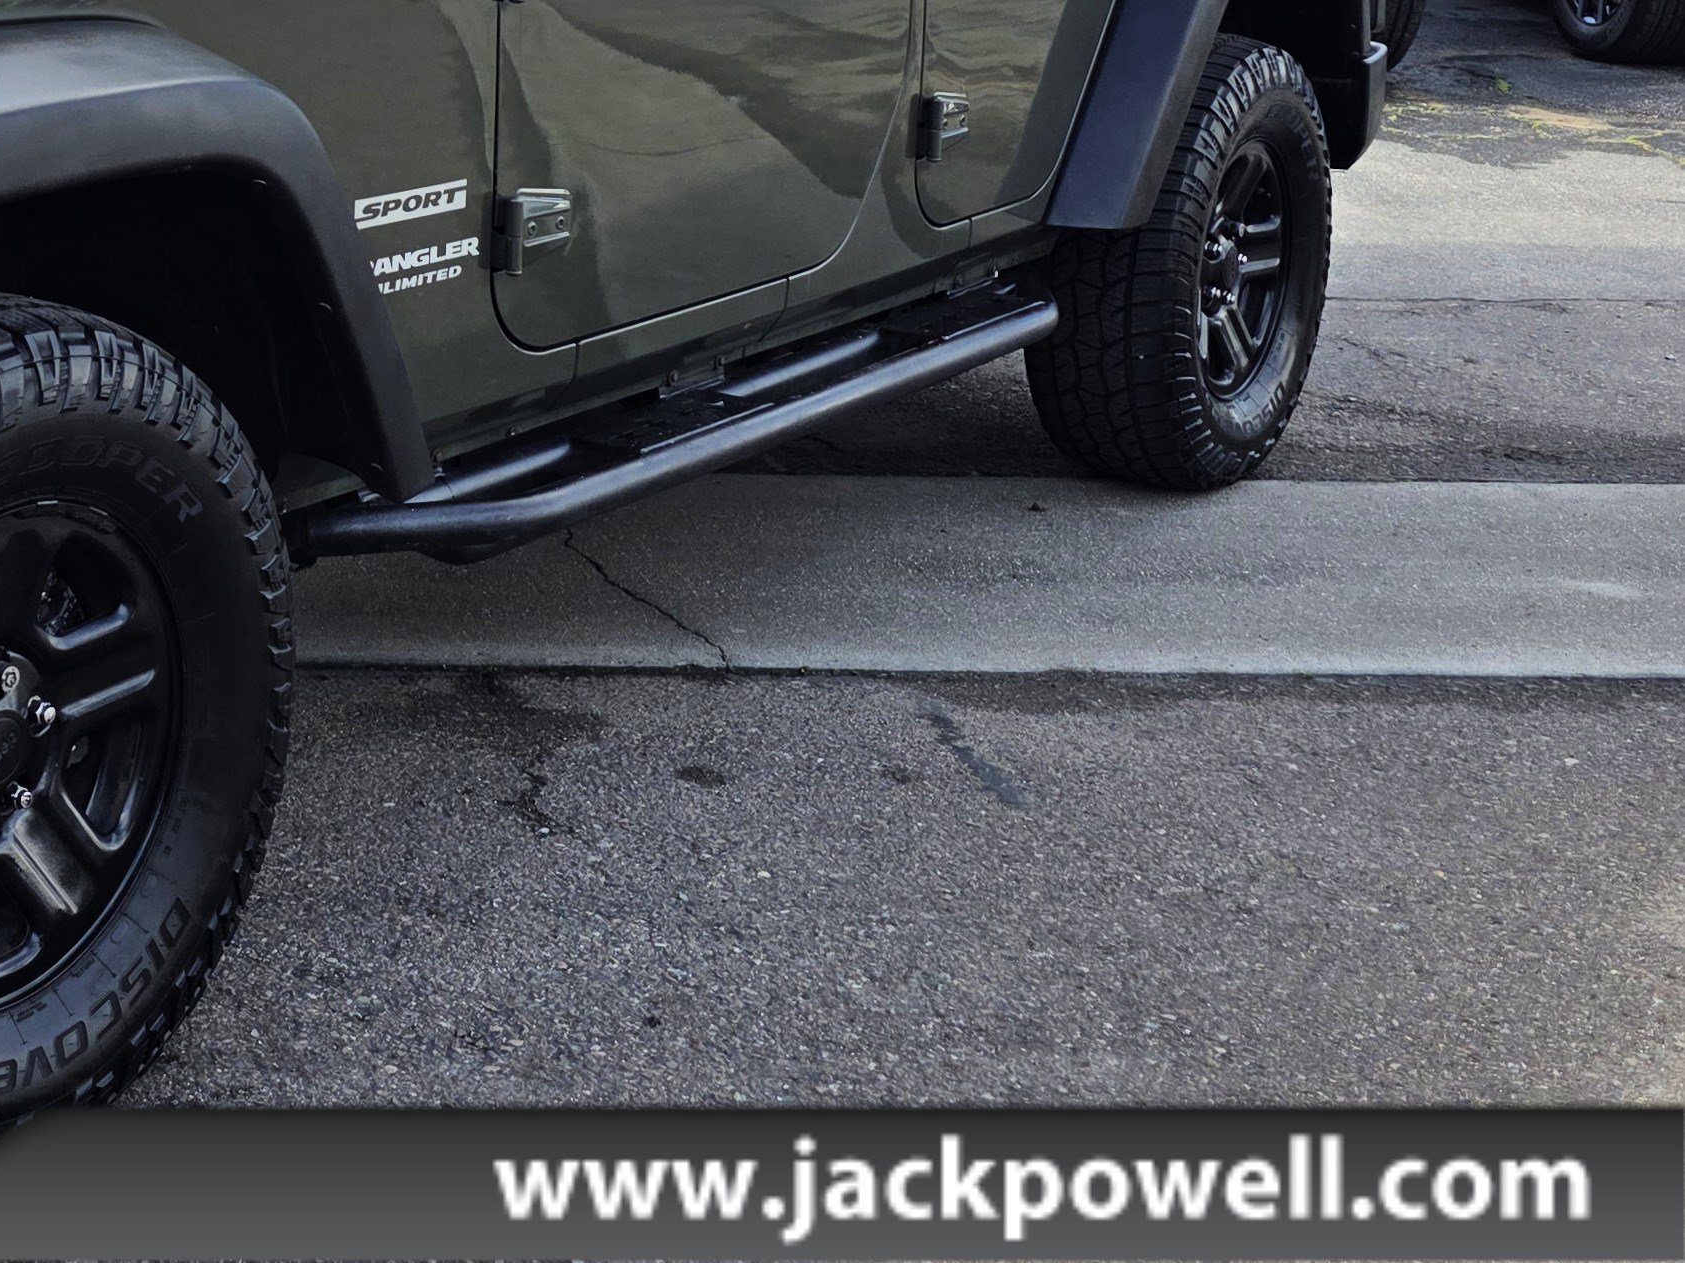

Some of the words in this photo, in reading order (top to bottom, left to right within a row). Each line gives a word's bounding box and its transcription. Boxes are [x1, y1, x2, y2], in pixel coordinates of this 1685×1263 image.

[356, 186, 467, 220] SPORT
[370, 236, 480, 276] ANGLER
[378, 265, 462, 294] LIMITED
